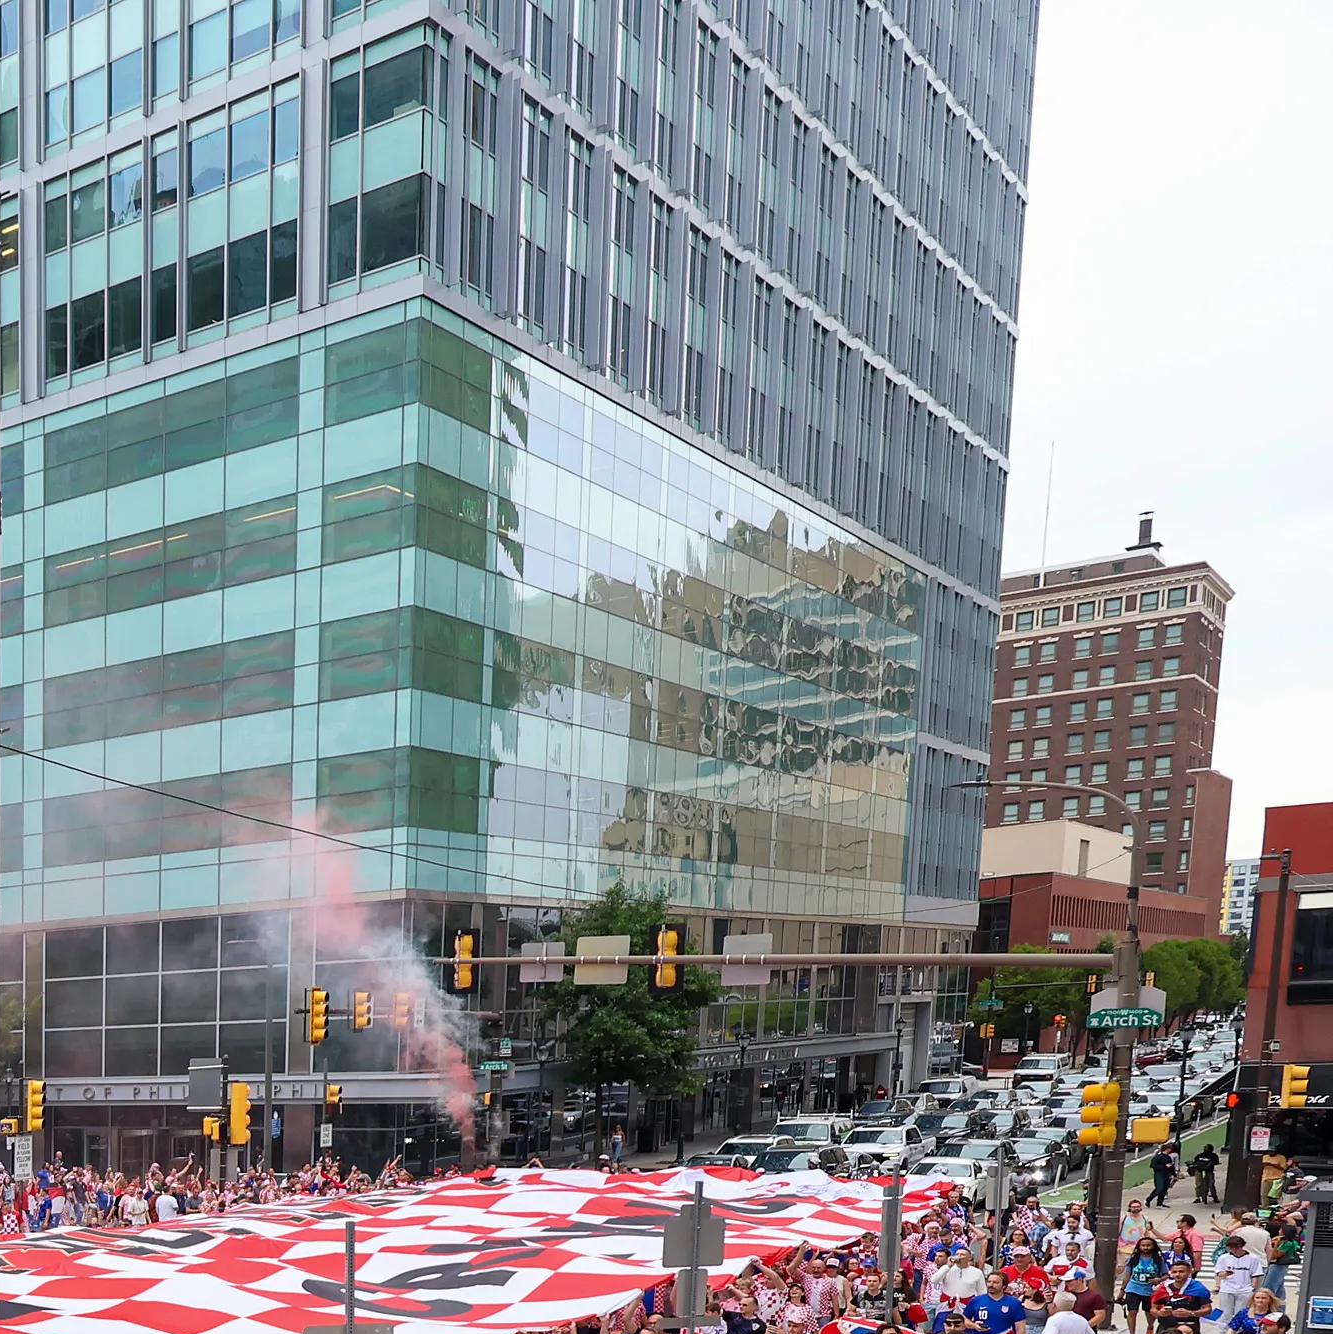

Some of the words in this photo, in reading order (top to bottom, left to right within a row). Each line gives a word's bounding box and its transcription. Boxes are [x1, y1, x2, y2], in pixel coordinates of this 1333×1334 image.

[1101, 1015, 1138, 1027] Arch
[1142, 1014, 1159, 1026] St
[83, 1087, 112, 1100] OF
